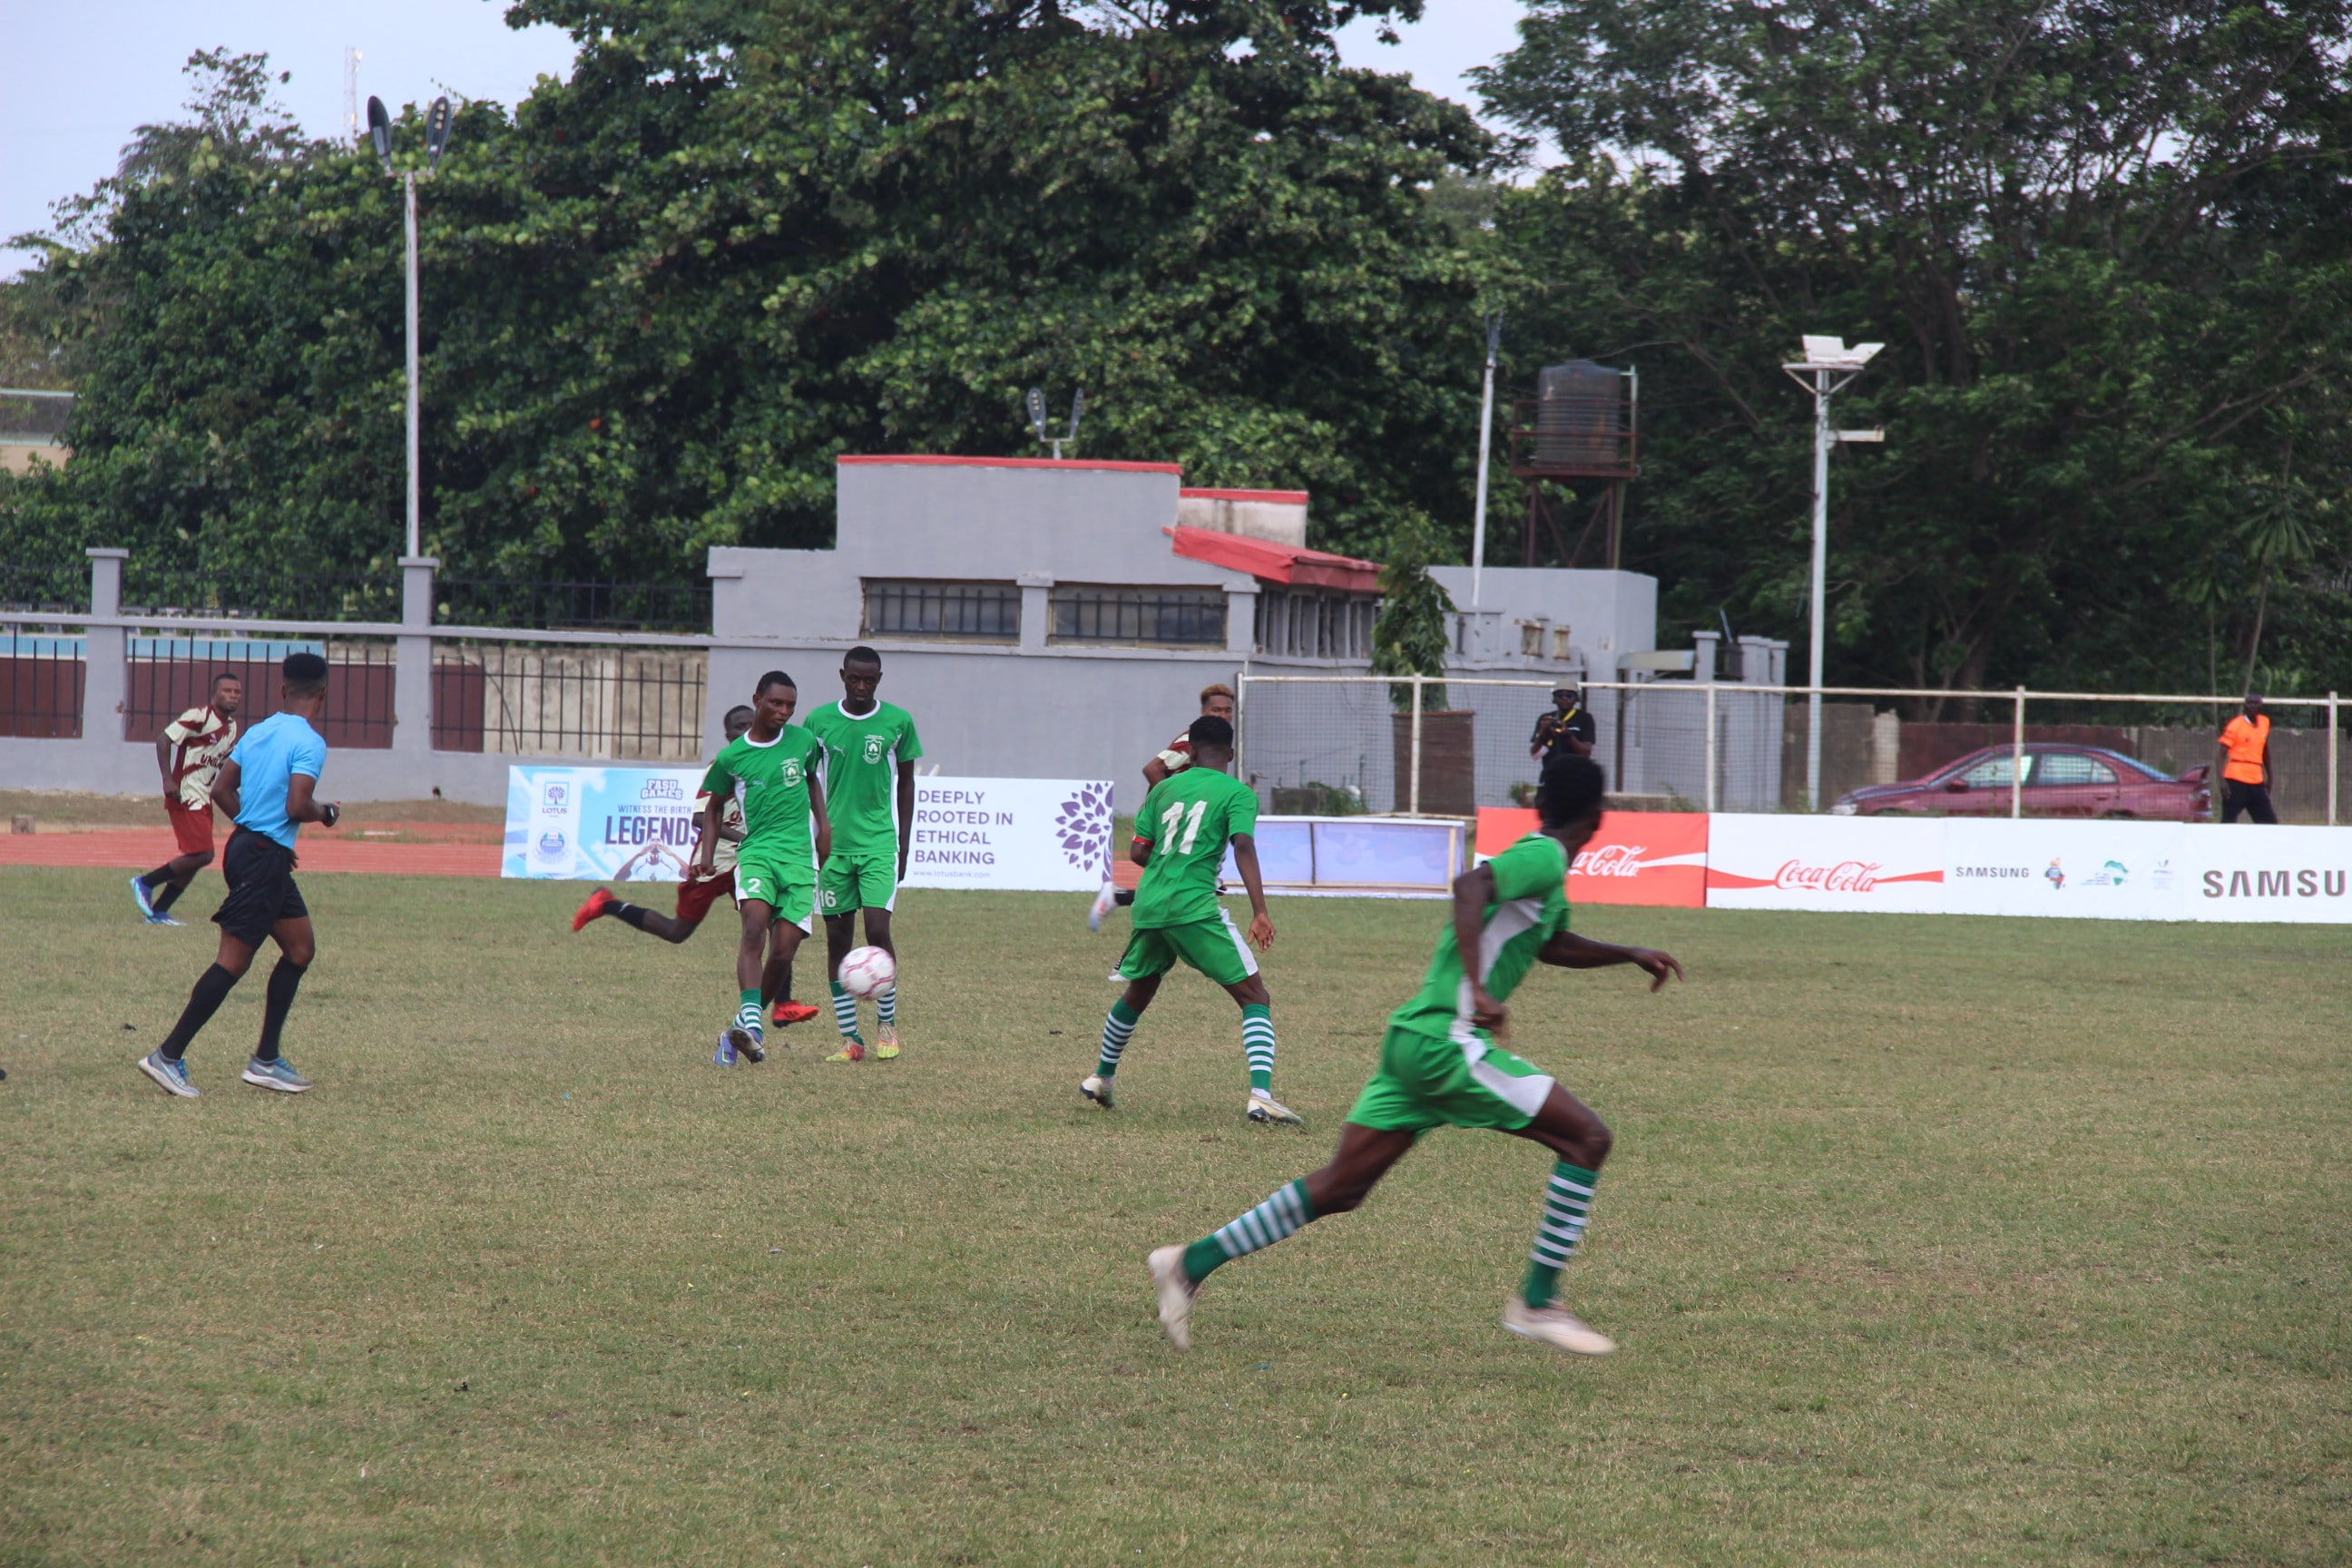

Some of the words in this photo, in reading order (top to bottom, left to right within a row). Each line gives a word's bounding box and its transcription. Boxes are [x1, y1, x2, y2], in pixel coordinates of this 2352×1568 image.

[647, 779, 678, 790] FASU
[641, 789, 682, 799] GAMES
[918, 790, 985, 804] DEEPLY
[618, 804, 652, 814] WITNESS
[654, 805, 668, 814] THE
[671, 806, 692, 815] BIRTH
[916, 809, 990, 825] ROOTED
[995, 812, 1014, 826] IN
[1161, 799, 1208, 855] 11
[916, 829, 992, 845] ETHICAL
[915, 849, 995, 865] BANKING
[1567, 845, 1648, 877] a-Cola
[913, 870, 991, 878] www.lotusbank.com
[1774, 859, 1884, 892] Coca-Cola
[1955, 867, 2030, 877] SAMSUNG
[748, 877, 761, 894] 2
[819, 889, 837, 908] 16
